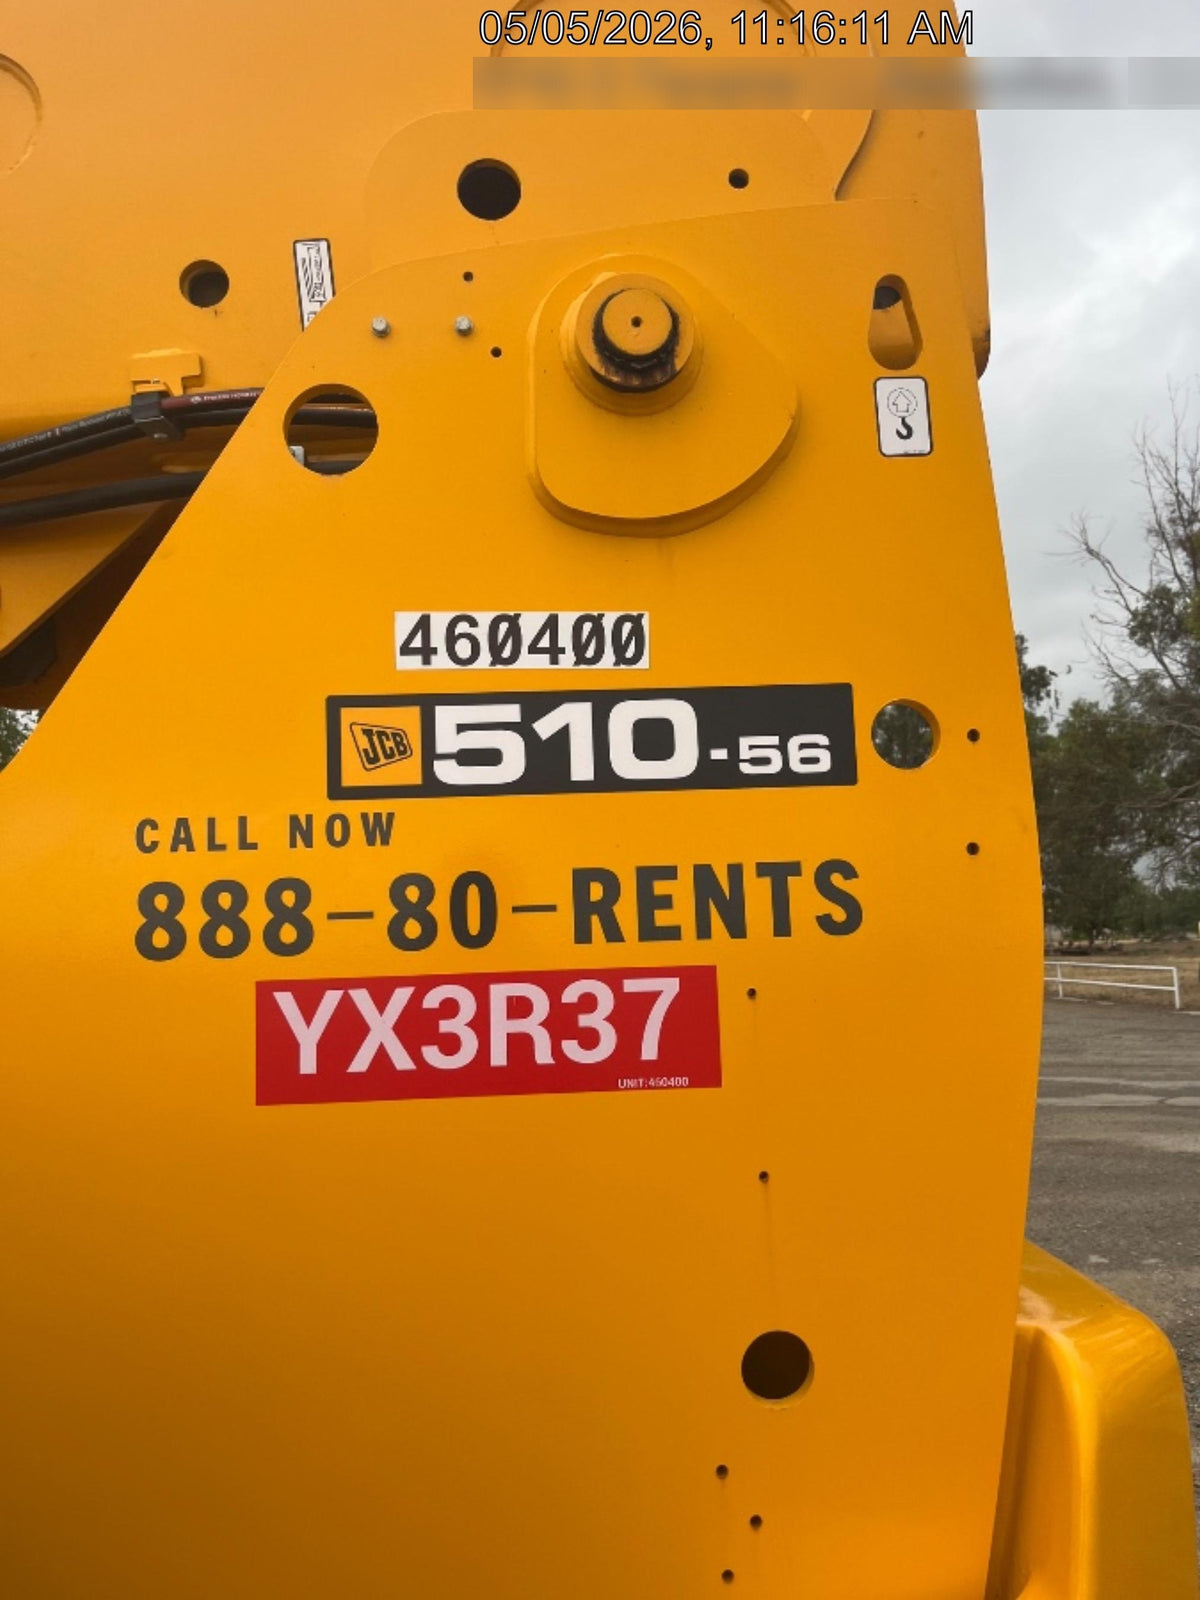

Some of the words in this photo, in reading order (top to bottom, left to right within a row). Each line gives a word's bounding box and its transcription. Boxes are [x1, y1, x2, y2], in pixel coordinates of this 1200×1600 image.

[361, 728, 408, 765] JCB
[135, 815, 259, 854] CALL
[289, 812, 395, 848] NOW
[135, 859, 864, 961] 888-80-RENTS
[274, 977, 681, 1075] YX3R37
